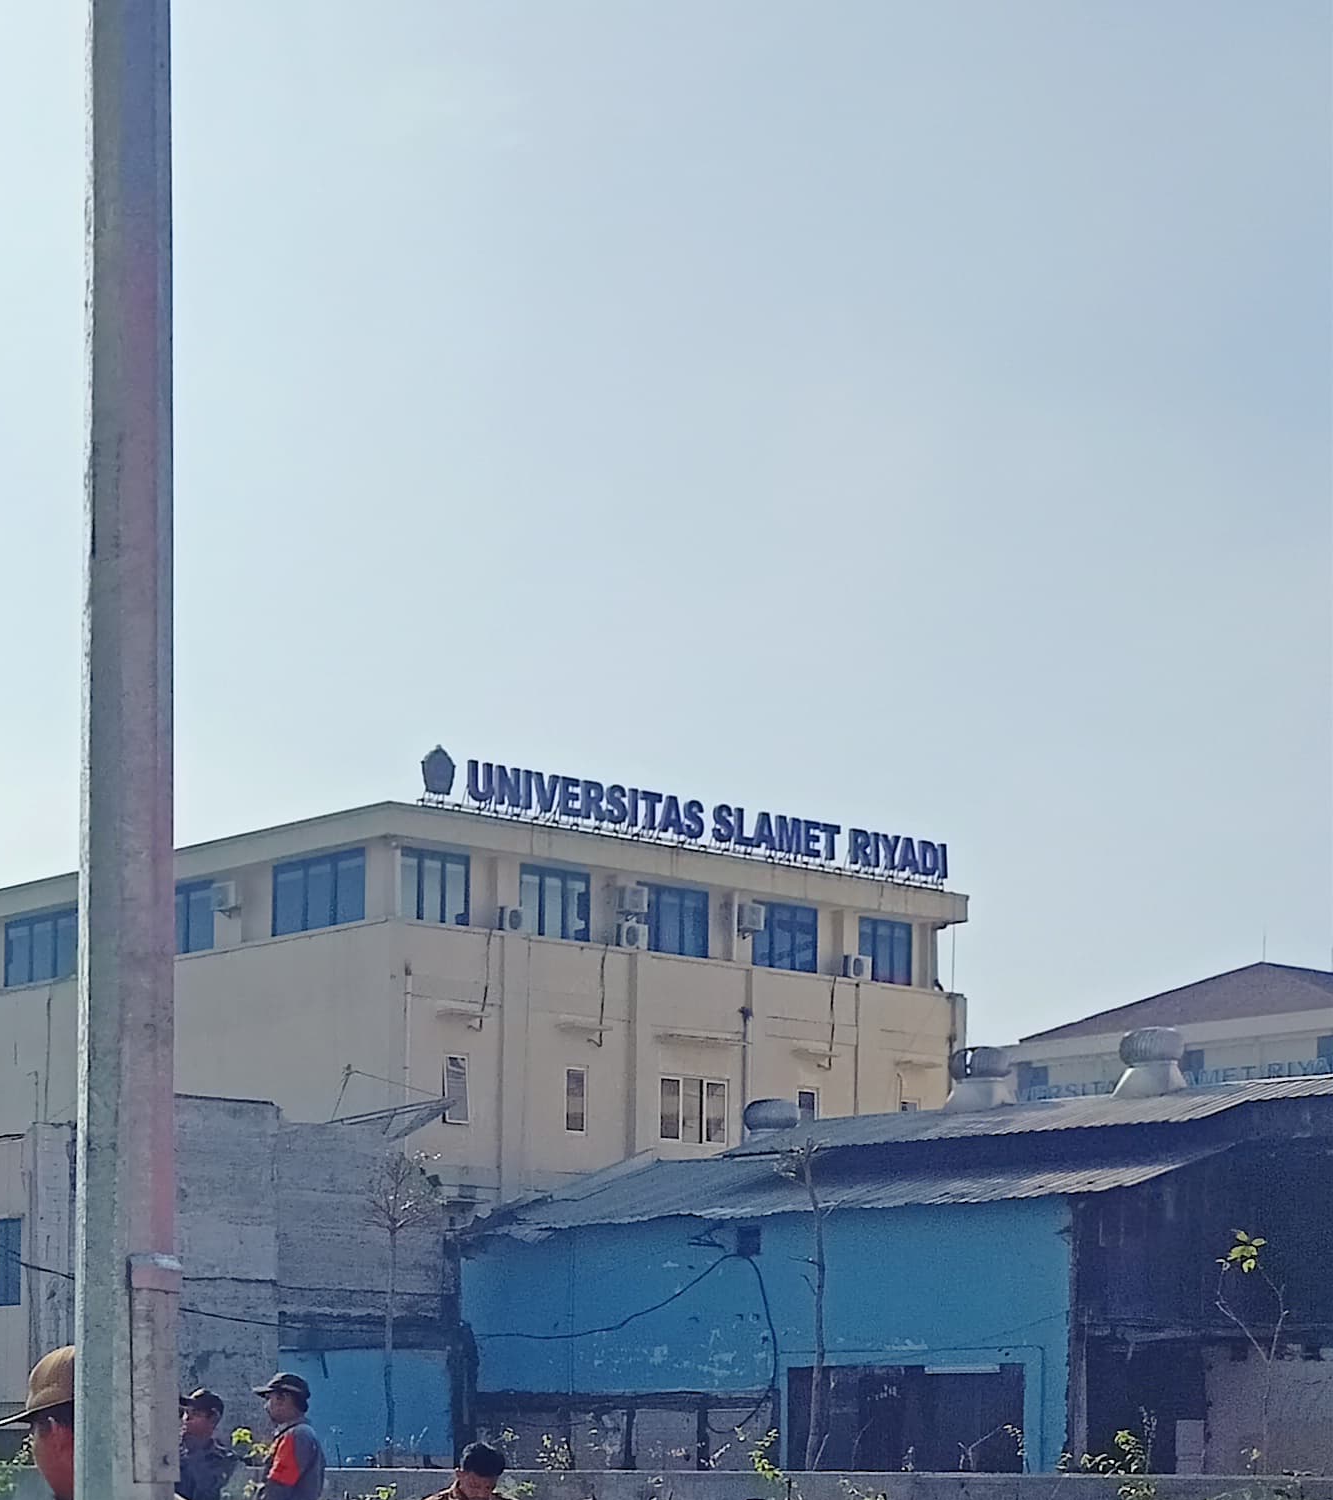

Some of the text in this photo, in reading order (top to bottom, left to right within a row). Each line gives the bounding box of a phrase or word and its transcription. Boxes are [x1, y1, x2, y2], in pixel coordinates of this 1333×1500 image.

[467, 759, 948, 879] UNIVERSITAS SLAMET RIYADI
[1183, 1066, 1256, 1085] AMET
[1267, 1056, 1333, 1078] RIYA
